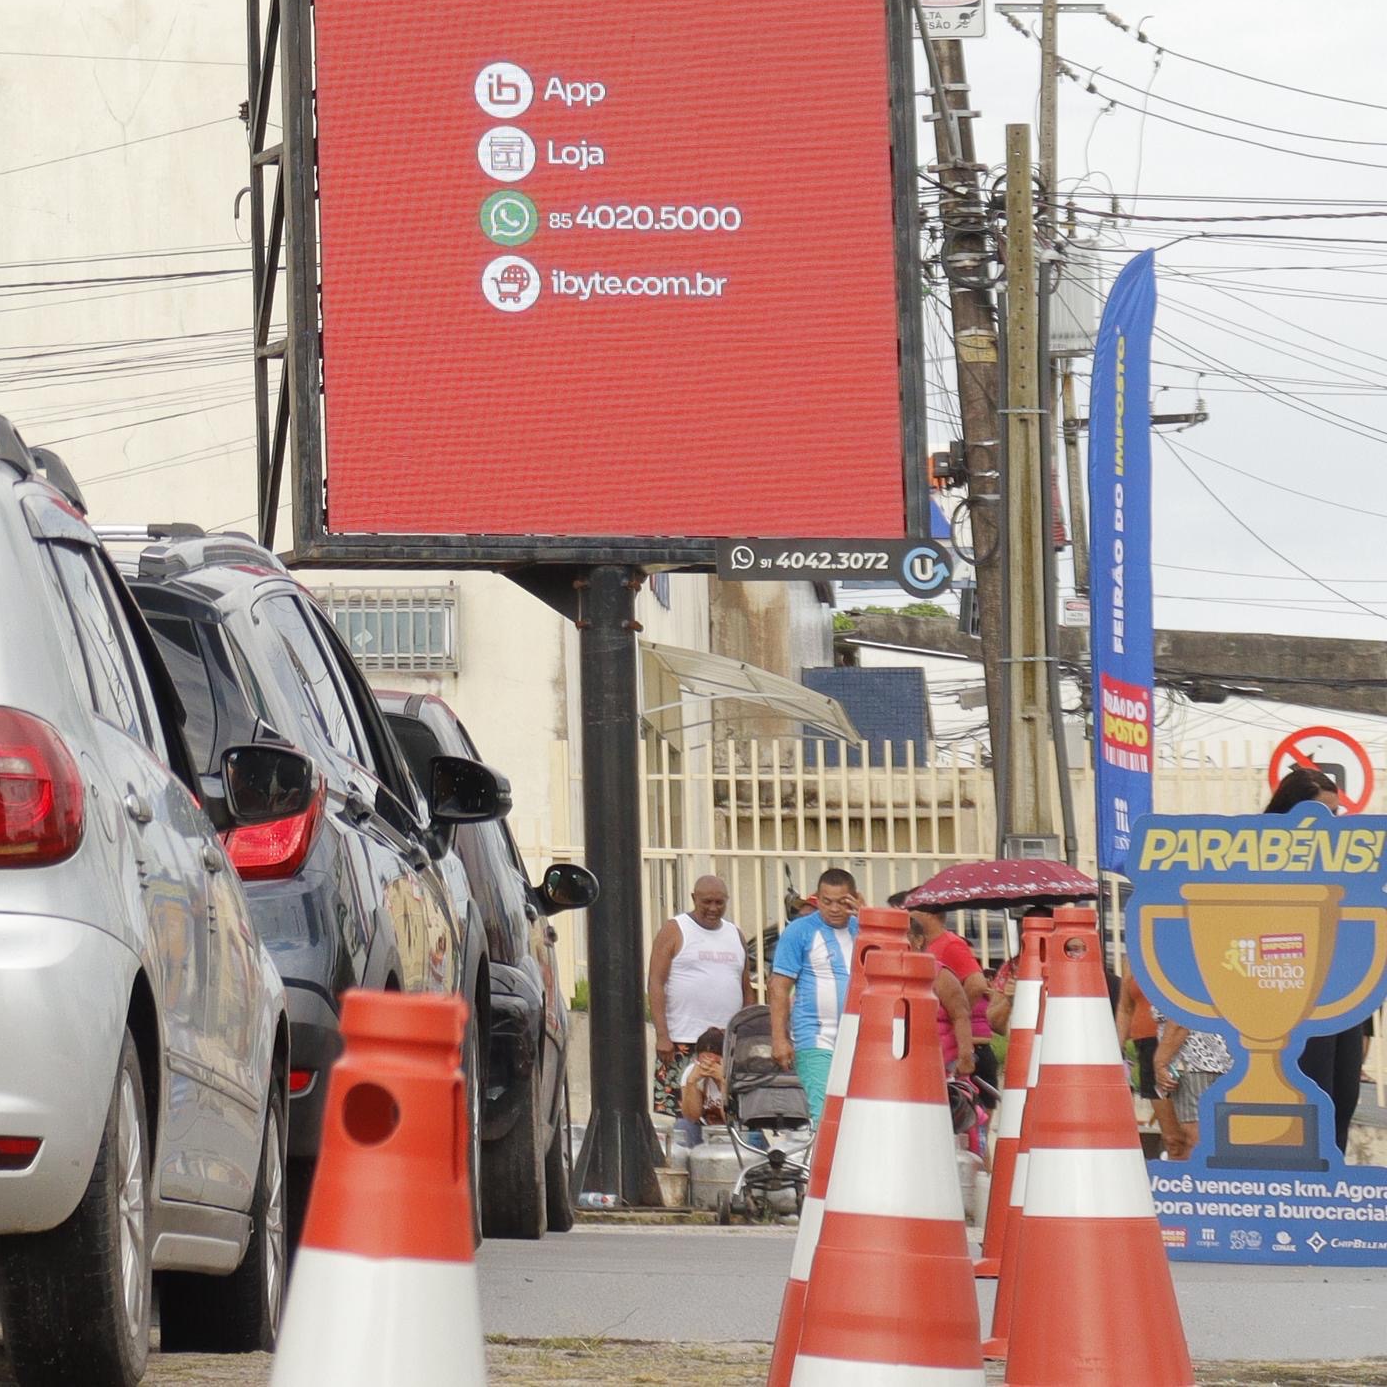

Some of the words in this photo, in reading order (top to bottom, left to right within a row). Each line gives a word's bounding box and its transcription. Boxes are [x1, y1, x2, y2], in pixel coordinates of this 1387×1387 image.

[543, 77, 606, 107] App
[547, 140, 605, 170] Loja
[549, 213, 572, 229] 85
[576, 204, 741, 231] 4020.5000
[551, 269, 727, 300] ibyte.com.br
[1114, 335, 1126, 477] IMPOSTO
[1114, 483, 1125, 532] DO
[776, 552, 889, 570] 4042.3072
[1112, 540, 1125, 655] FEIRÃO
[1138, 817, 1387, 873] PARABÉNS!
[1243, 961, 1305, 979] Treinão
[1195, 1180, 1265, 1196] venceu
[1268, 1182, 1292, 1197] os
[1295, 1180, 1331, 1198] km.
[1195, 1201, 1261, 1218] vencer
[1265, 1205, 1277, 1218] a
